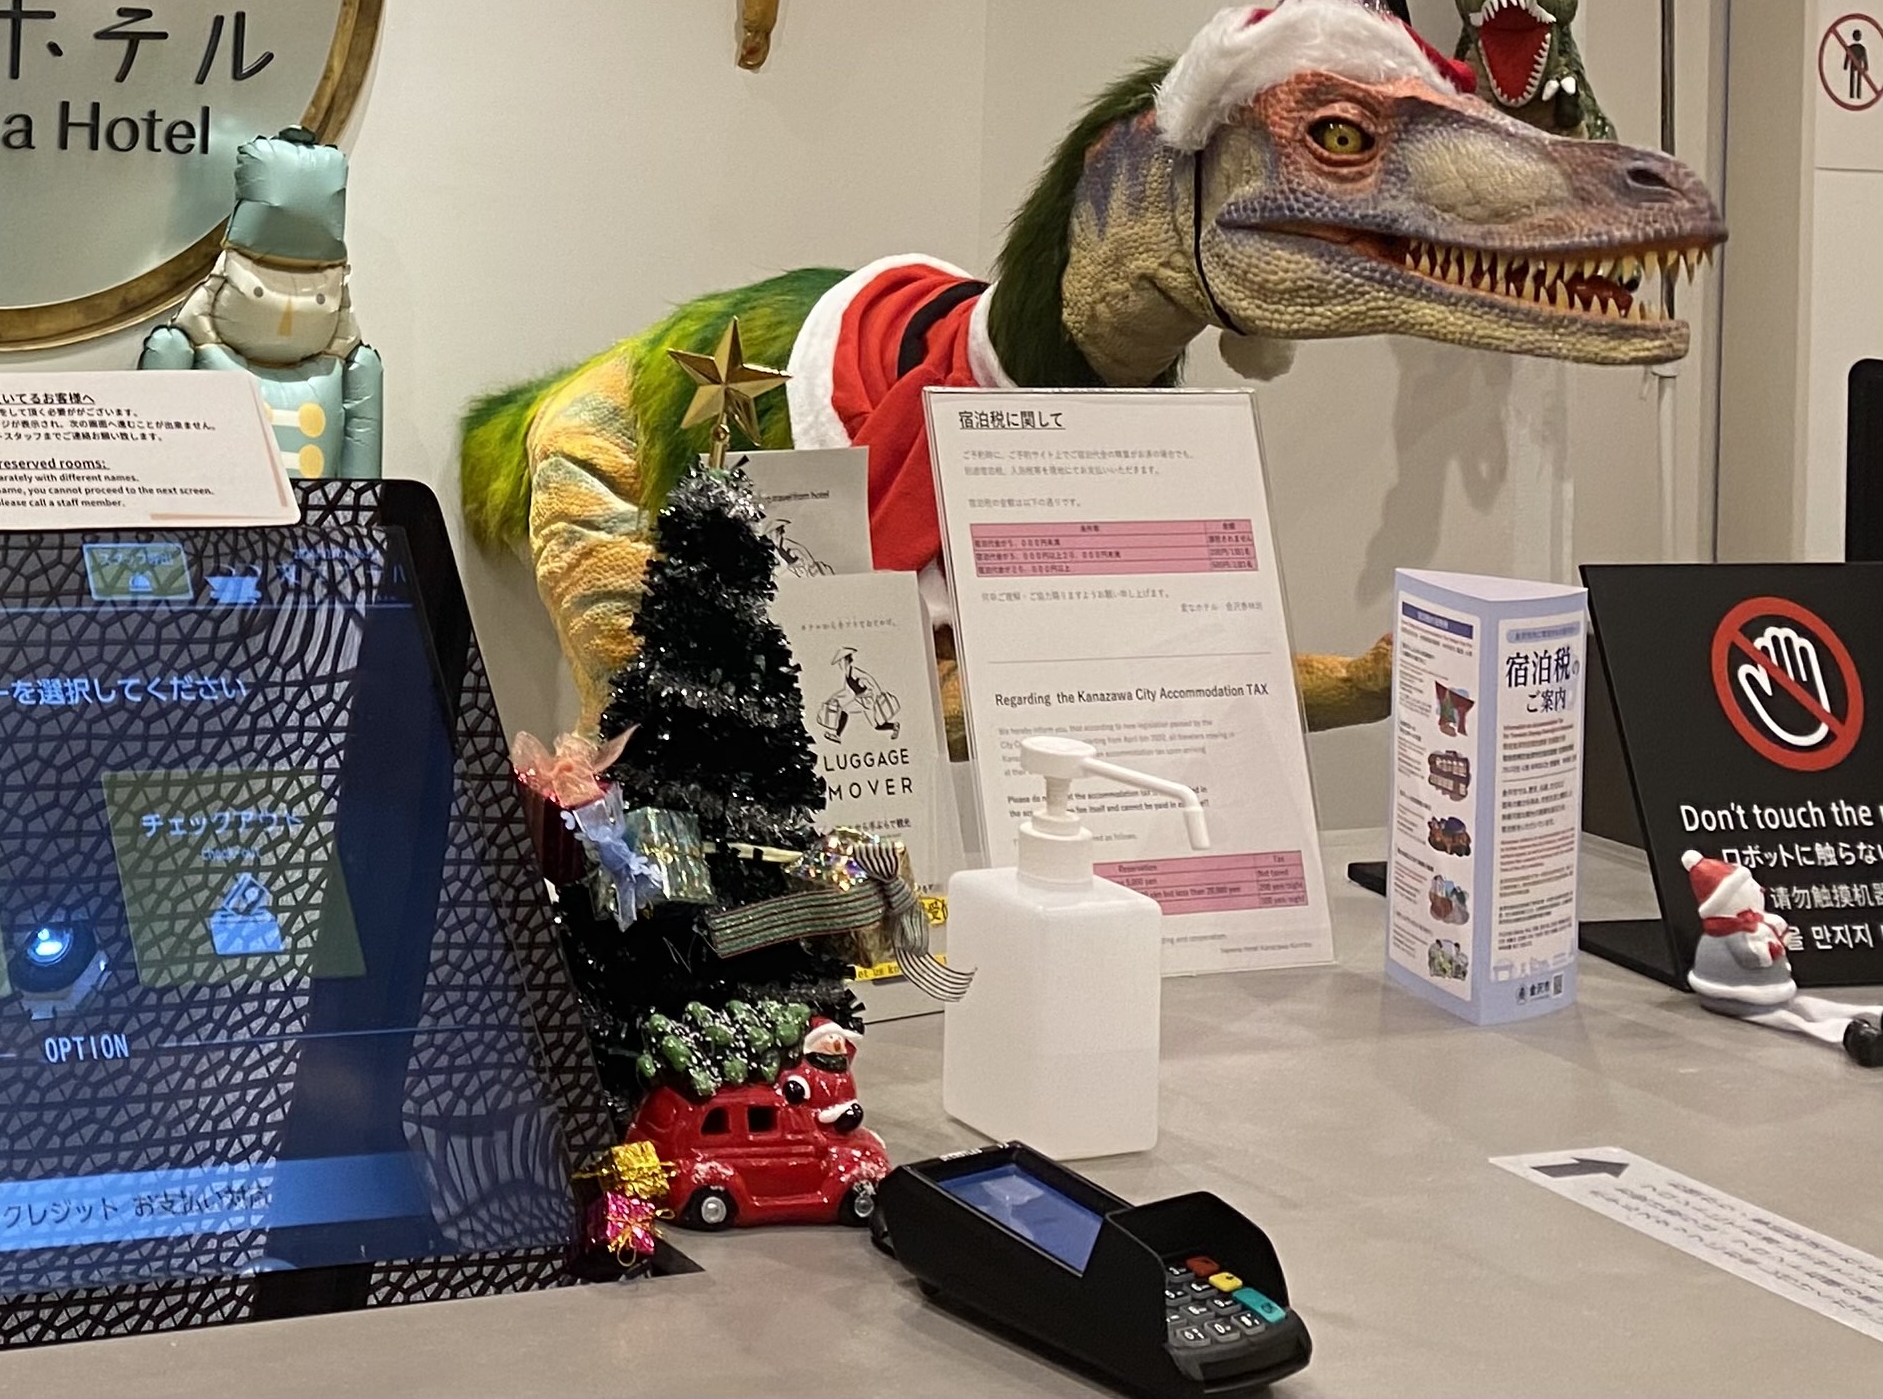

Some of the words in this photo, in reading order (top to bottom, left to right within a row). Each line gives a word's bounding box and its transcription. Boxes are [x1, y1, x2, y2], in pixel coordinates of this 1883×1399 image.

[59, 100, 211, 155] Hotel
[958, 410, 1064, 429] 宿泊税に関して
[59, 459, 107, 470] rooms:
[35, 473, 57, 482] with
[60, 473, 102, 482] different
[28, 487, 47, 497] you
[49, 486, 83, 495] cannot
[85, 486, 124, 497] proceed
[138, 486, 154, 495] the
[156, 487, 178, 495] next
[180, 488, 214, 496] screen.
[29, 499, 47, 508] call
[57, 499, 79, 508] staff
[81, 499, 126, 508] member.
[1505, 644, 1580, 689] 宿泊税の
[995, 693, 1051, 708] Regarding
[1057, 692, 1075, 704] the
[1077, 690, 1133, 703] Kanazawa
[1135, 688, 1157, 702] City
[1159, 685, 1244, 700] Accommodation
[1247, 683, 1269, 696] TAX
[1526, 686, 1567, 713] ご案内
[824, 748, 910, 772] LUGGAGE
[828, 777, 913, 802] MOVER
[141, 809, 302, 838] チェックアウト
[1679, 802, 1749, 832] Don't
[1752, 800, 1827, 830] touch
[1830, 799, 1874, 828] the
[1811, 922, 1874, 951] 만지지
[44, 1034, 129, 1064] OPTION
